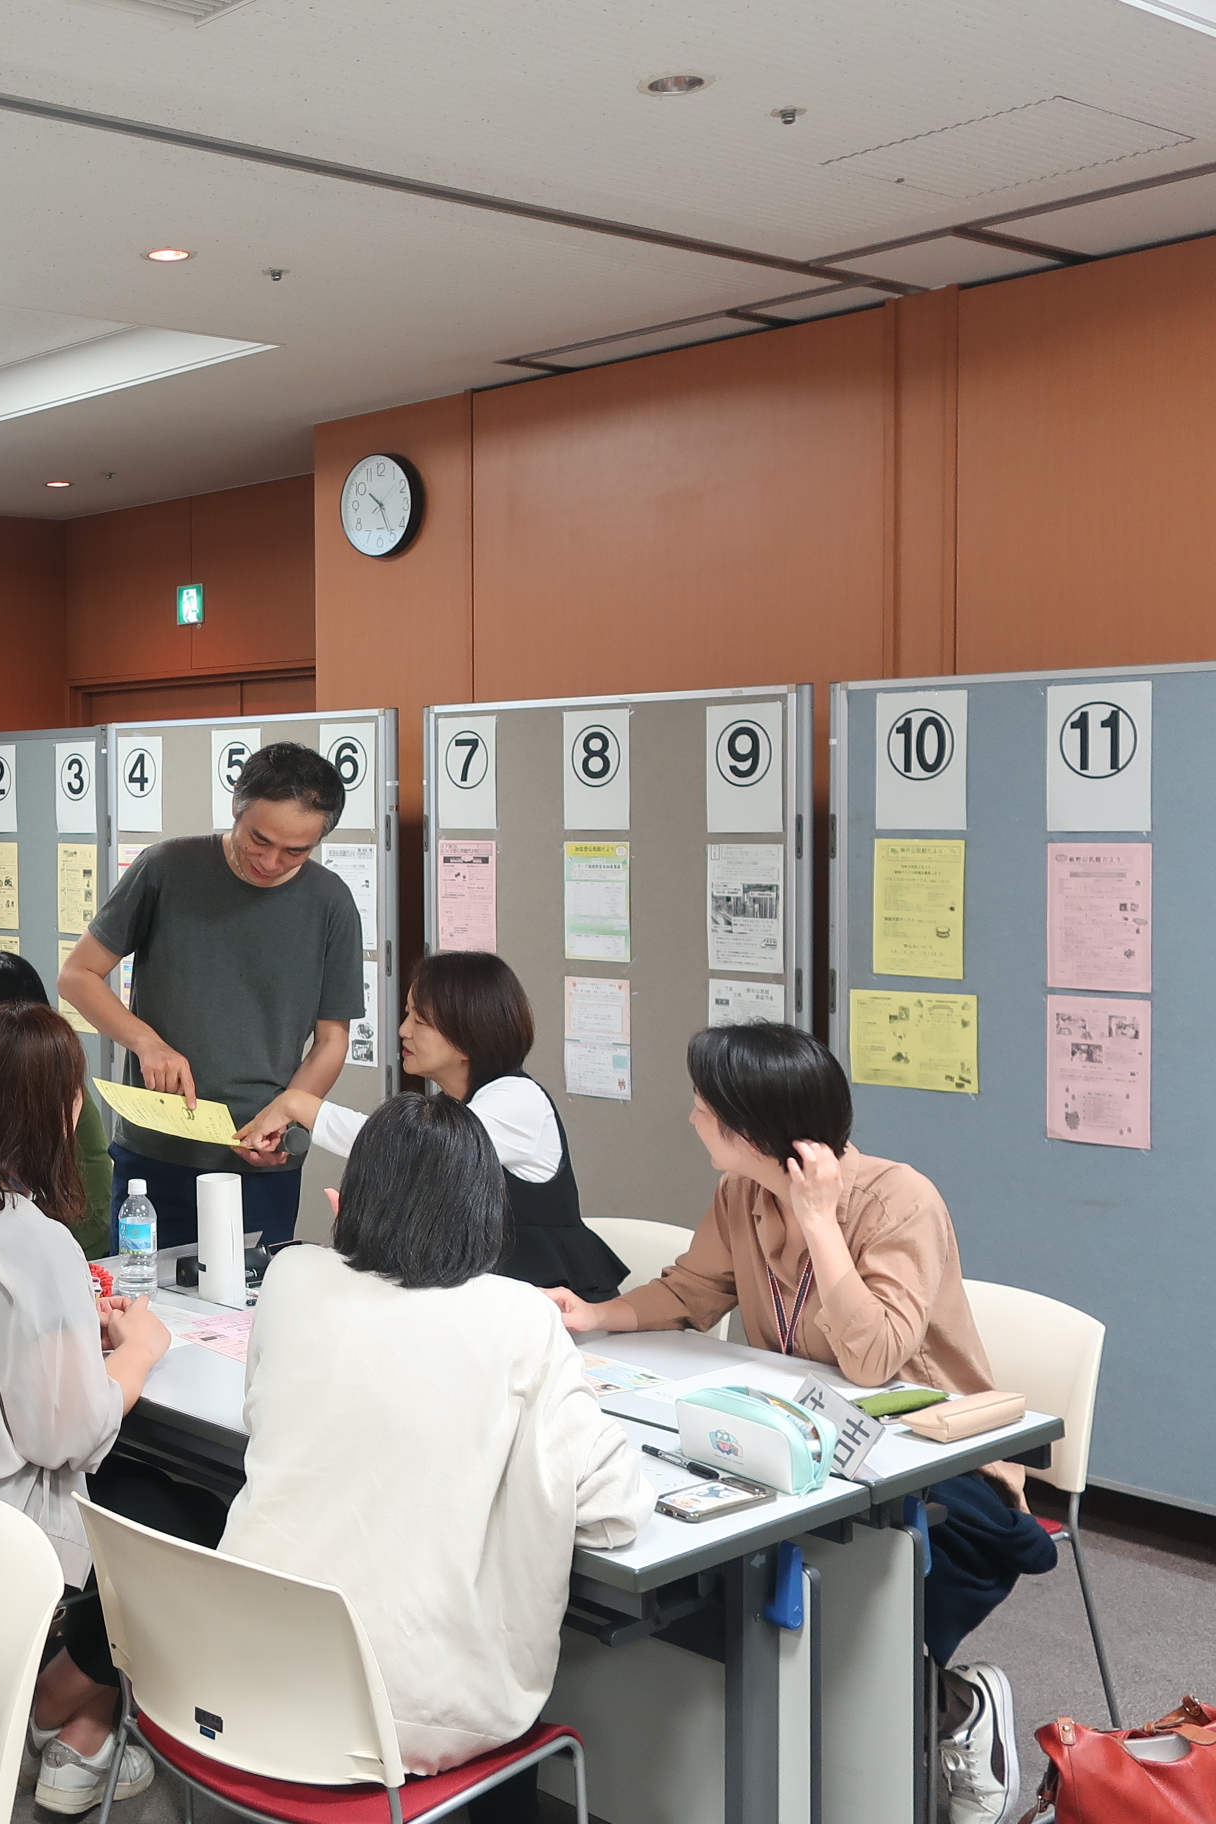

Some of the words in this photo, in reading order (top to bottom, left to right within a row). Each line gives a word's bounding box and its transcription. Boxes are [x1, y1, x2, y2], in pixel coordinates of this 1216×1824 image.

[365, 467, 372, 482] 11
[376, 462, 386, 477] 12
[355, 481, 367, 496] 10
[399, 479, 407, 494] 2
[351, 500, 360, 513] 9
[402, 496, 410, 511] 3
[355, 517, 363, 531] 8
[398, 515, 405, 528] 4
[364, 529, 372, 544] 7
[376, 534, 384, 548] 6
[389, 528, 397, 543] 5
